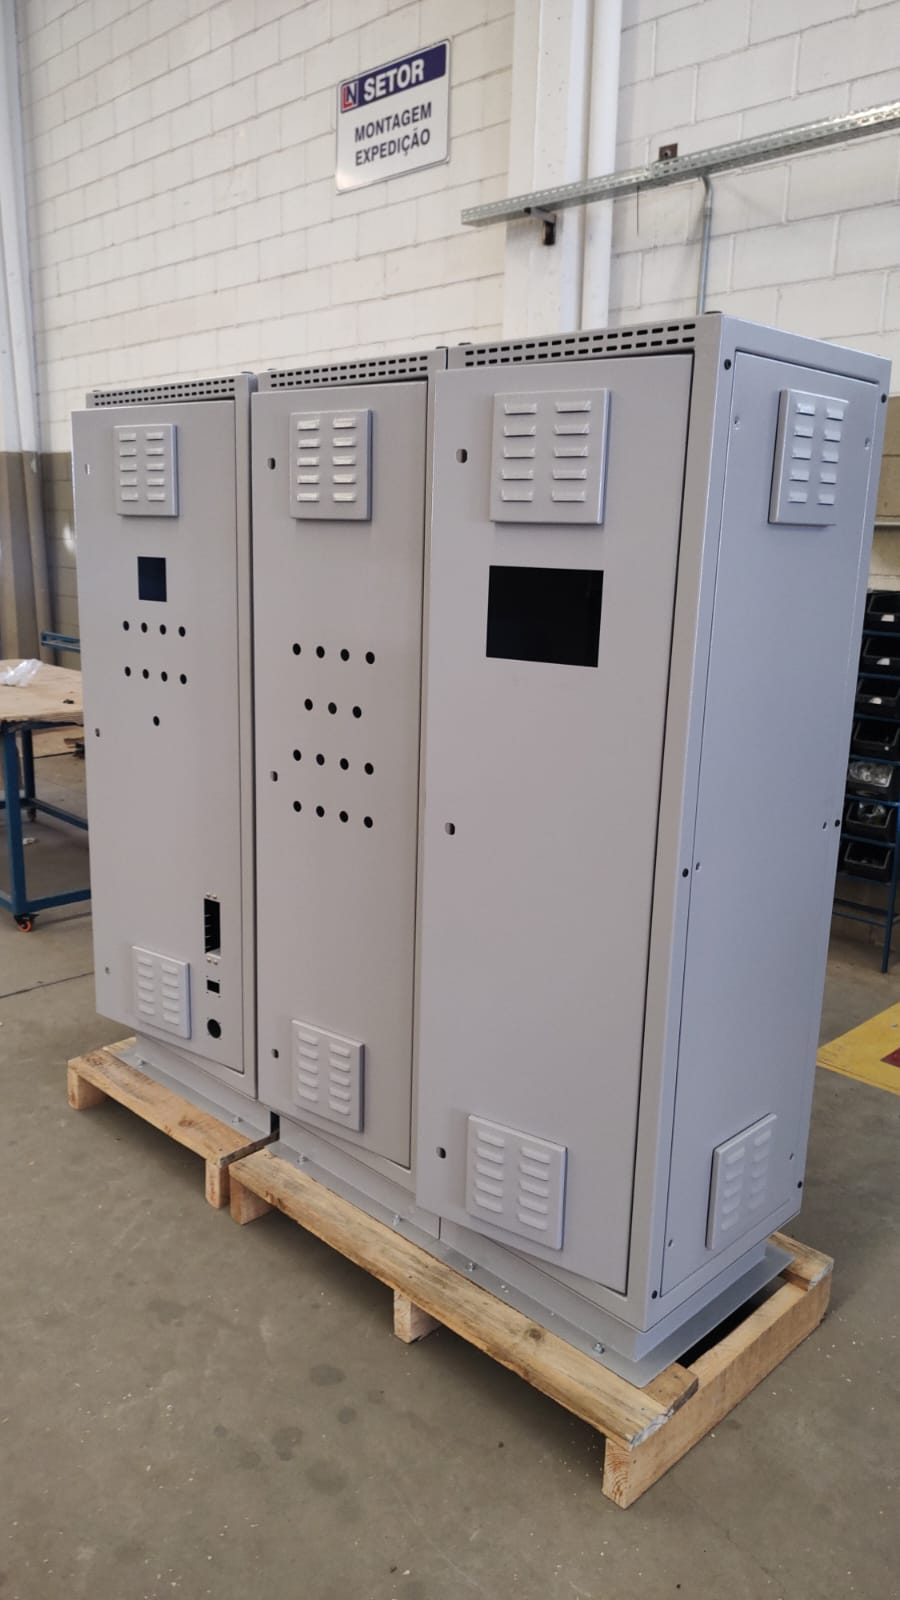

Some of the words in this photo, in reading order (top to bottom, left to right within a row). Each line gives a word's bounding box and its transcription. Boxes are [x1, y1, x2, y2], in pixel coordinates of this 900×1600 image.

[363, 58, 424, 101] SETOR
[354, 102, 432, 143] MONTAGEM
[355, 128, 431, 166] EXPEDIÇÃO
